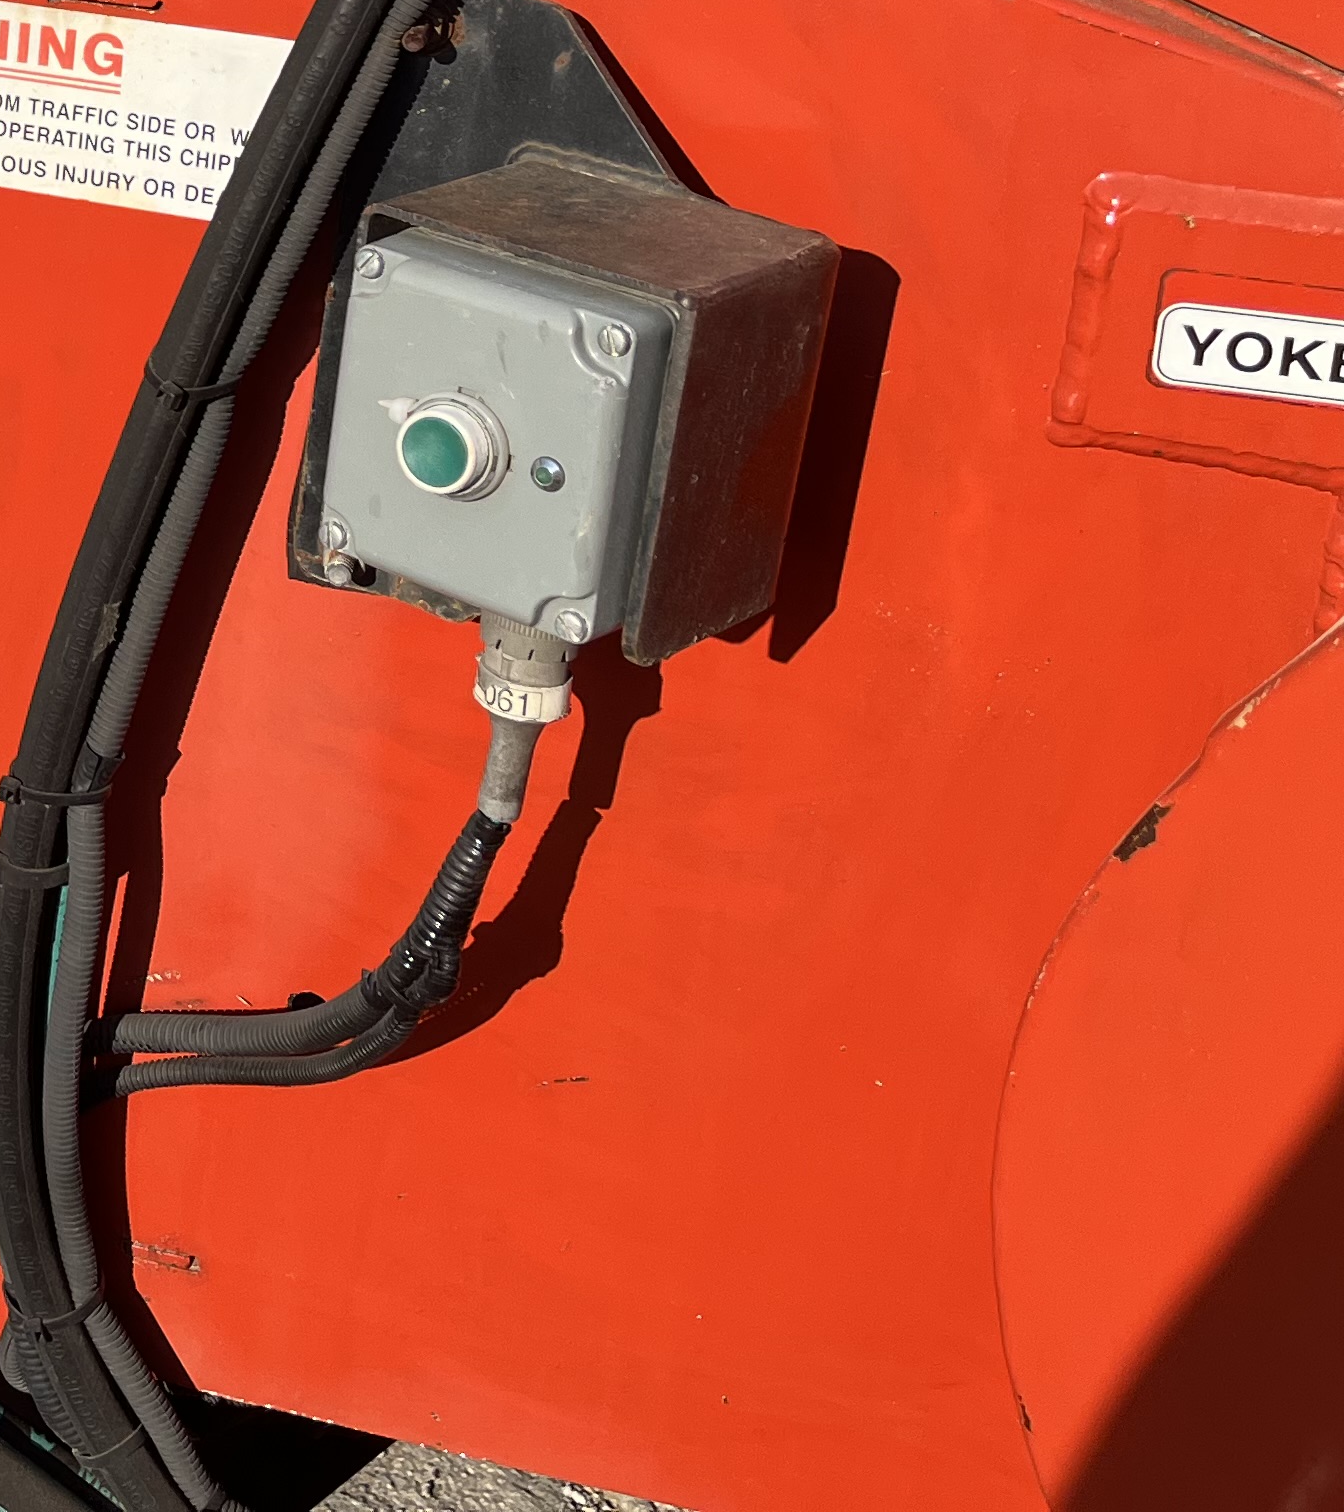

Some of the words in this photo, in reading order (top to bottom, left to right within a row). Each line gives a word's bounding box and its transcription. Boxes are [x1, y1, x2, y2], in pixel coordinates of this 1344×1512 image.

[28, 97, 119, 129] TRAFFIC
[126, 111, 176, 136] SIDE
[183, 122, 216, 144] OR
[123, 138, 171, 163] THIS
[55, 161, 135, 192] INJURY
[143, 177, 175, 199] OR
